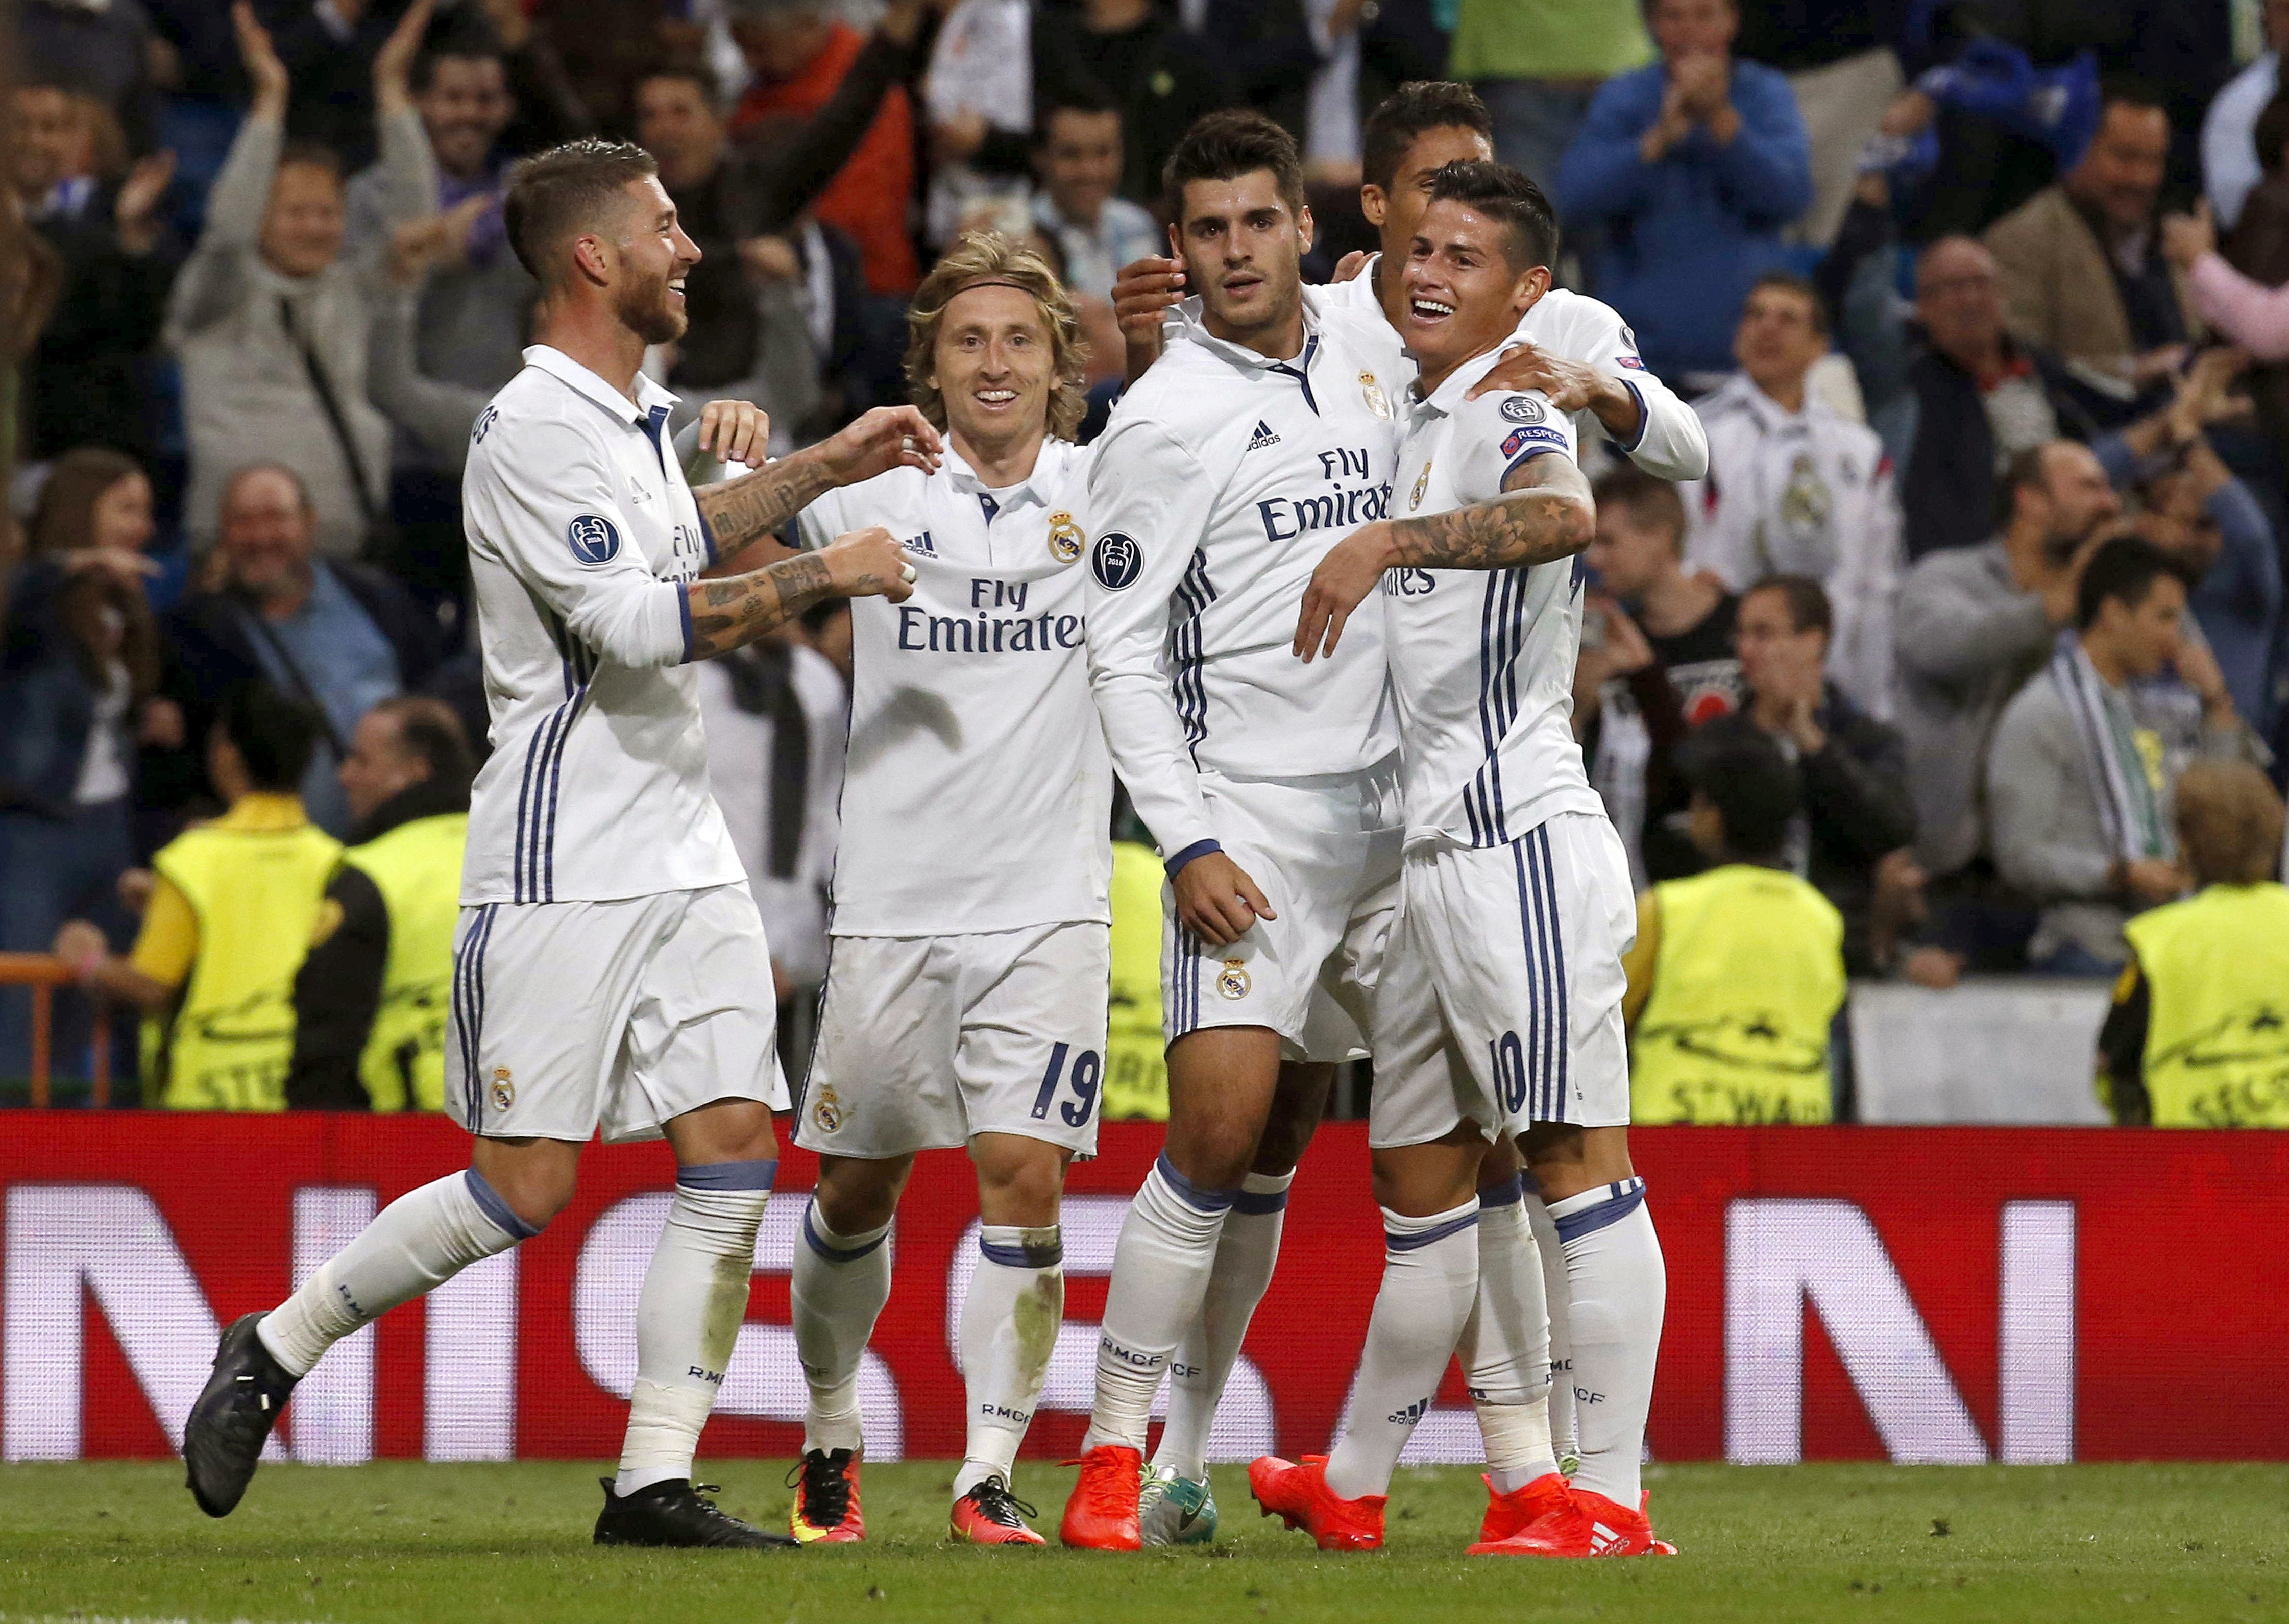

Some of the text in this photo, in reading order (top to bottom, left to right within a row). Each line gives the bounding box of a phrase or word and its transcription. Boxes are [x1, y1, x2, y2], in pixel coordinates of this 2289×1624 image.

[1517, 429, 1566, 445] RESPECT
[1317, 447, 1369, 479] Fly
[1256, 479, 1393, 542] Emirat
[673, 524, 700, 560] Fly
[1107, 557, 1124, 567] 2016
[971, 578, 1028, 612] Fly
[1030, 1041, 1100, 1128] 19
[1489, 1030, 1526, 1122] 10
[1103, 1337, 1162, 1366] RMCF
[1170, 1362, 1201, 1378] CF
[1573, 1387, 1605, 1404] CF
